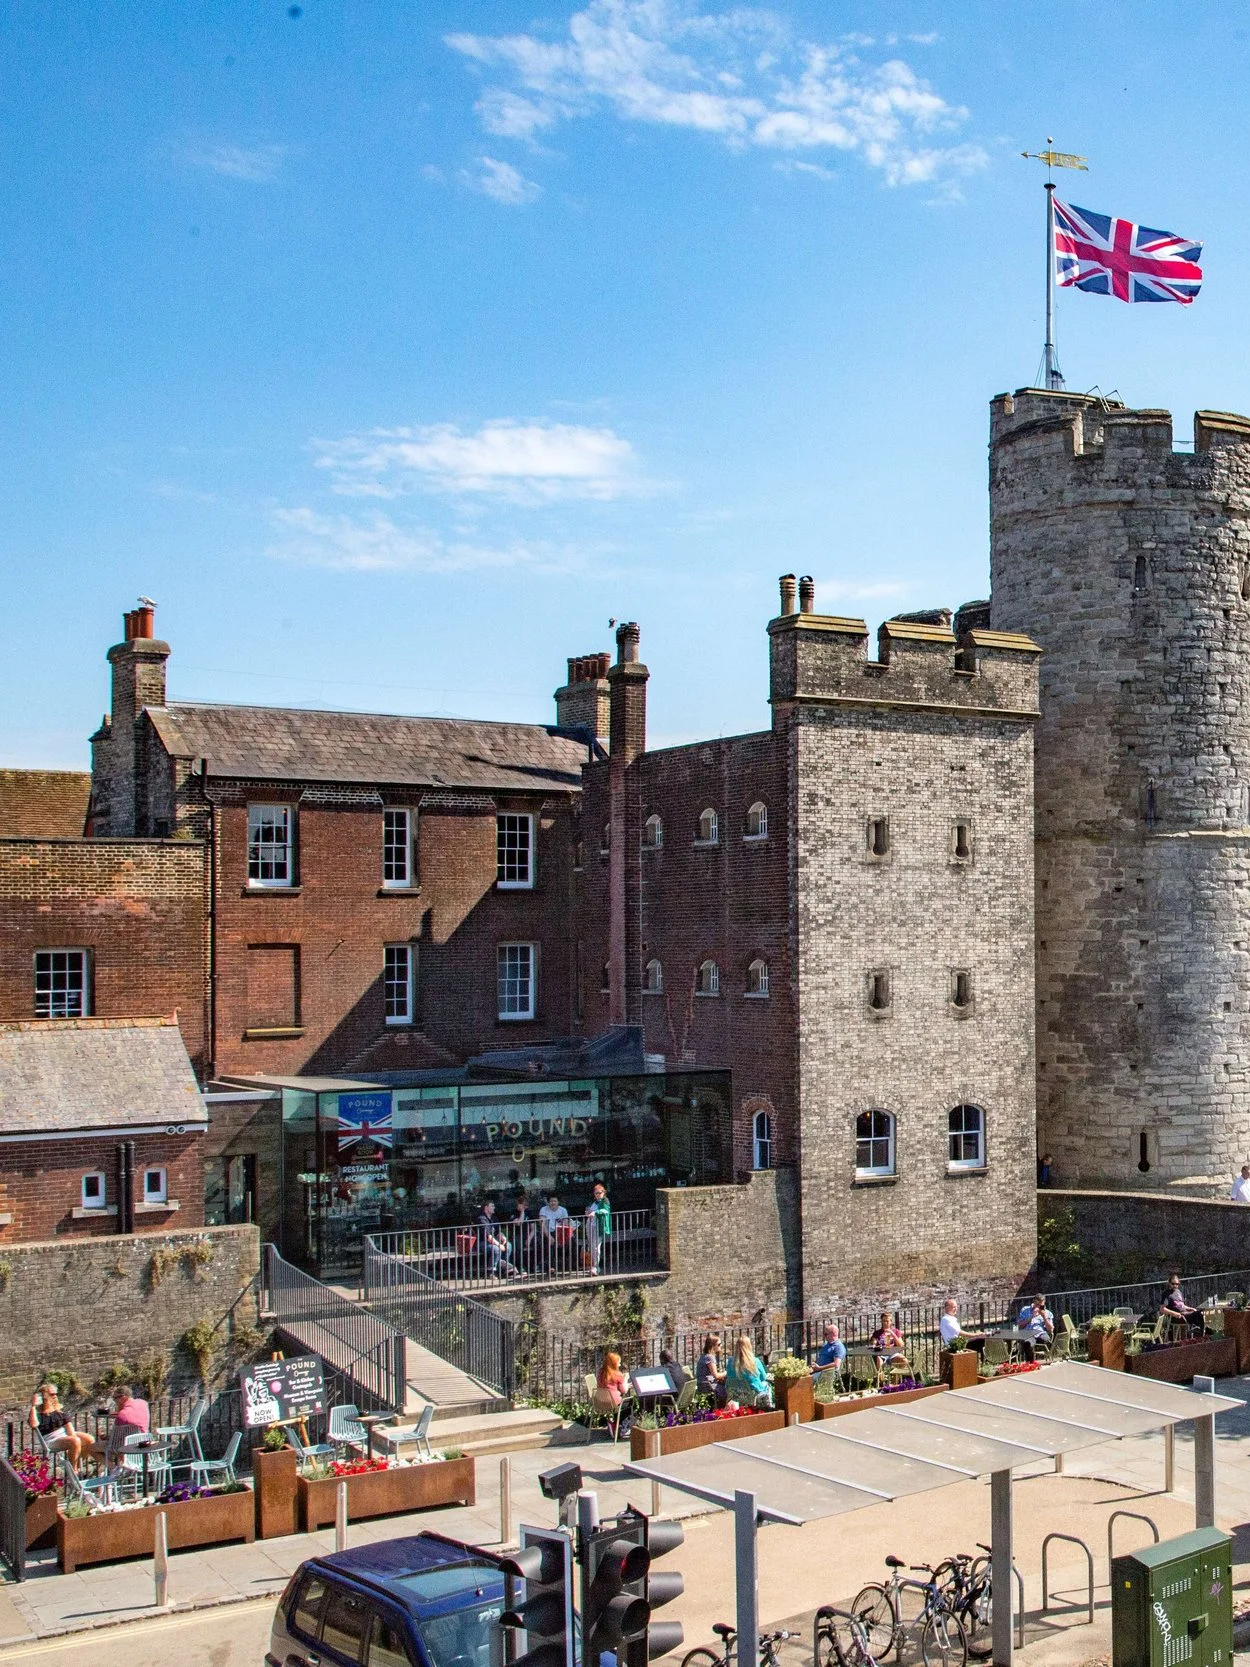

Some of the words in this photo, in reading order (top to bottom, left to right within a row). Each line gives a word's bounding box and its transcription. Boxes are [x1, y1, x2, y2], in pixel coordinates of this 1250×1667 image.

[348, 1100, 382, 1108] POUND
[486, 1119, 587, 1143] POUND
[342, 1164, 389, 1173] RESTAURANT
[367, 1173, 387, 1181] OPEN
[286, 1361, 316, 1372] POUND
